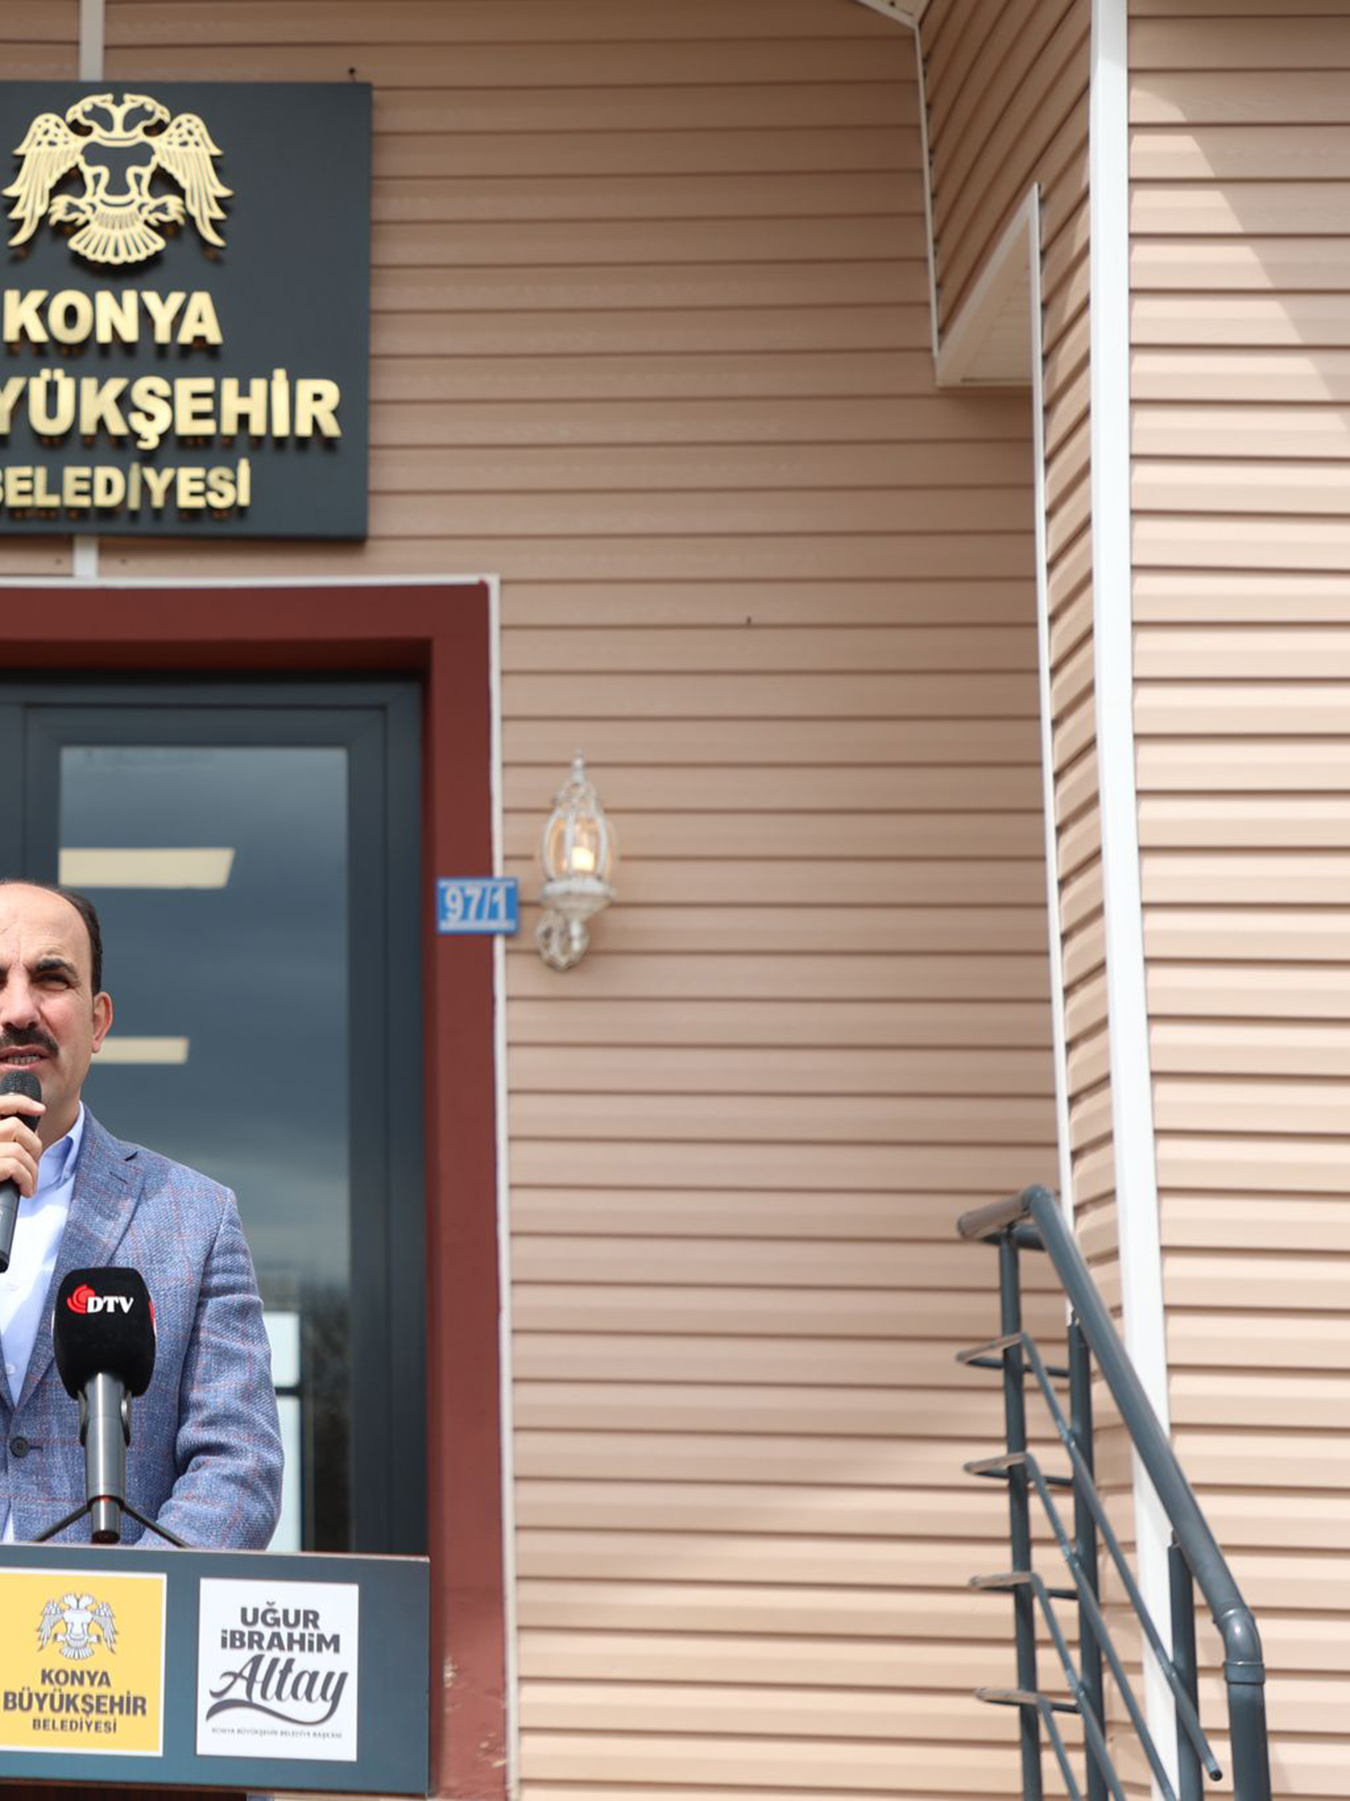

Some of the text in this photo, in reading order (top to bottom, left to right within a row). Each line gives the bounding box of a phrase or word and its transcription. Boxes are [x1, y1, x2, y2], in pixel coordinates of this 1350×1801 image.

[3, 289, 224, 345] KONYA
[445, 885, 507, 921] 97/1
[87, 1296, 134, 1313] DTV
[240, 1601, 320, 1630] UĞUR
[41, 1668, 111, 1688] KONYA
[206, 1654, 349, 1726] Altay
[3, 1687, 147, 1717] BÜYÜKŞEHİR
[32, 1717, 117, 1734] BELEDİYESİ
